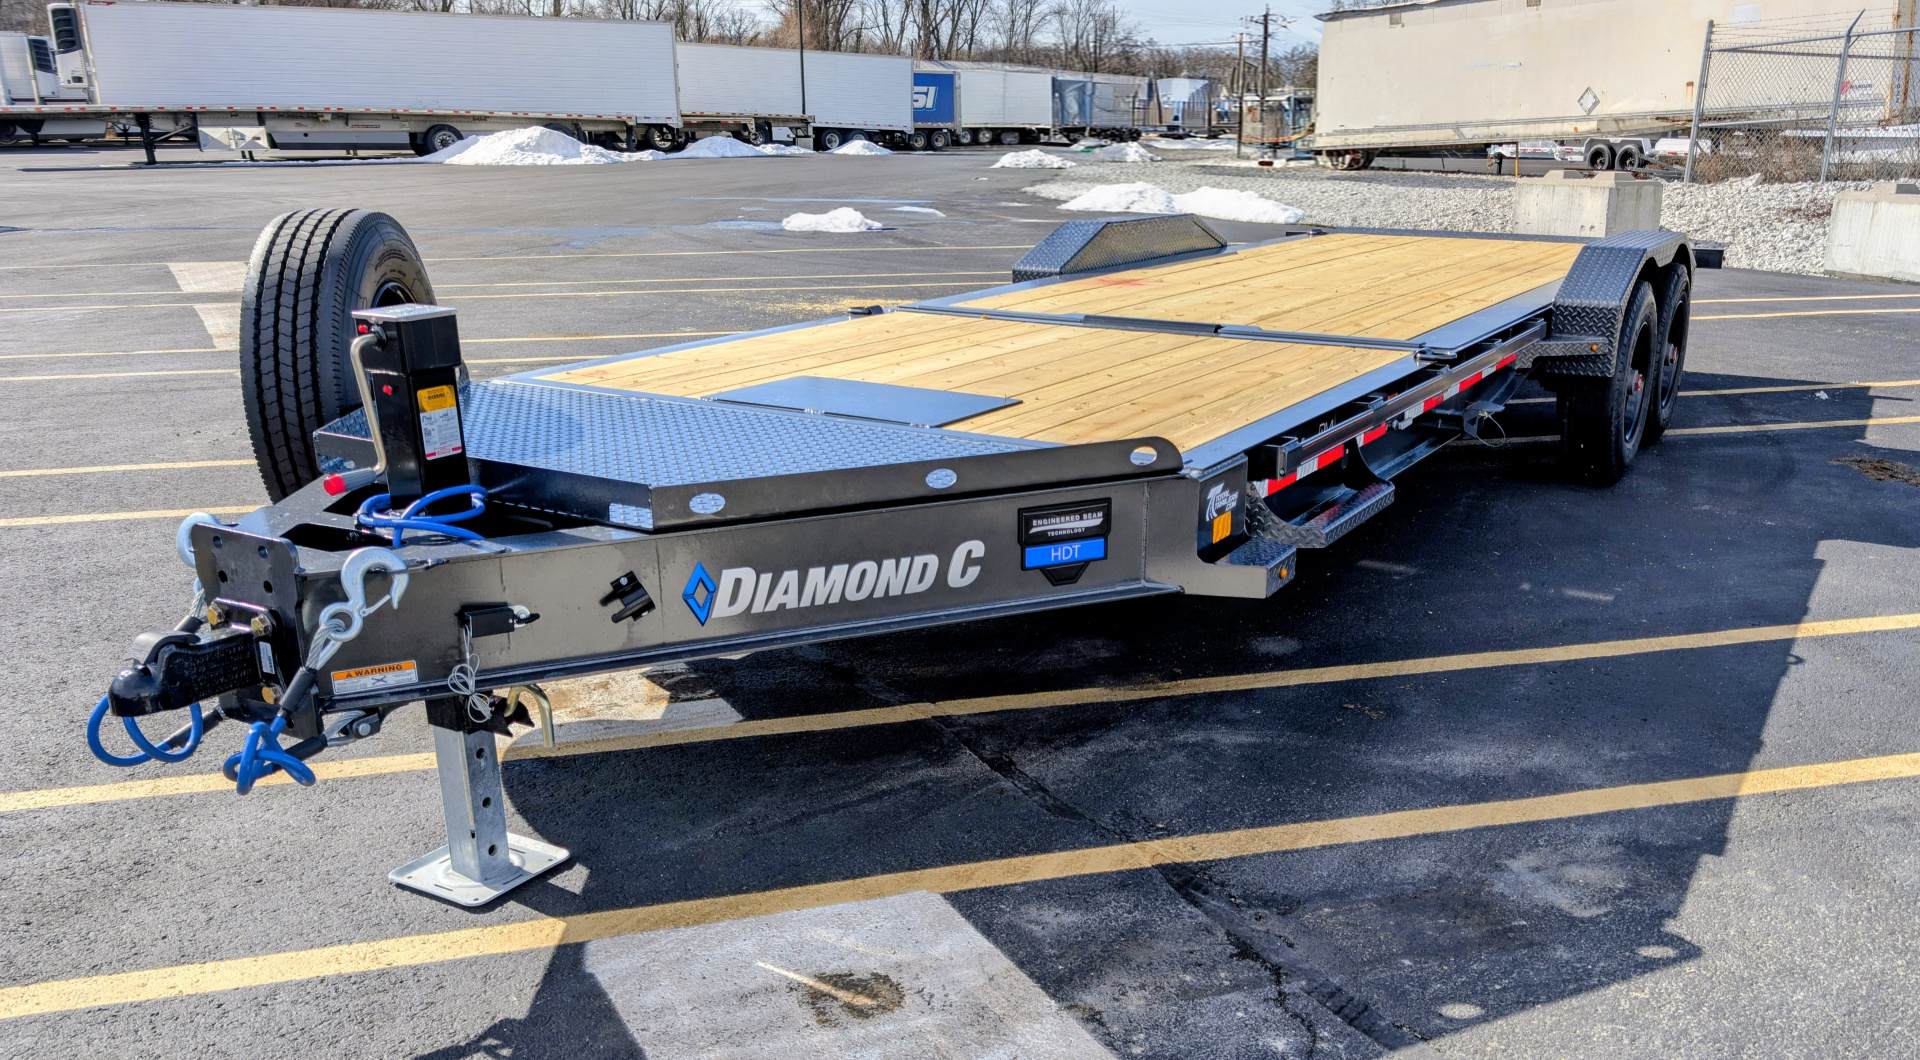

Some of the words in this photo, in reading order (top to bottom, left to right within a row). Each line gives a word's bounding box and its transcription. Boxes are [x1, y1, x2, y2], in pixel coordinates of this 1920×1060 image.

[1032, 515, 1081, 526] ENGINEERED
[1083, 511, 1103, 520] BEAM
[1047, 527, 1086, 537] TECHNOLOGY
[1051, 544, 1082, 562] HDT
[946, 539, 986, 588] C
[355, 664, 403, 677] WARNING
